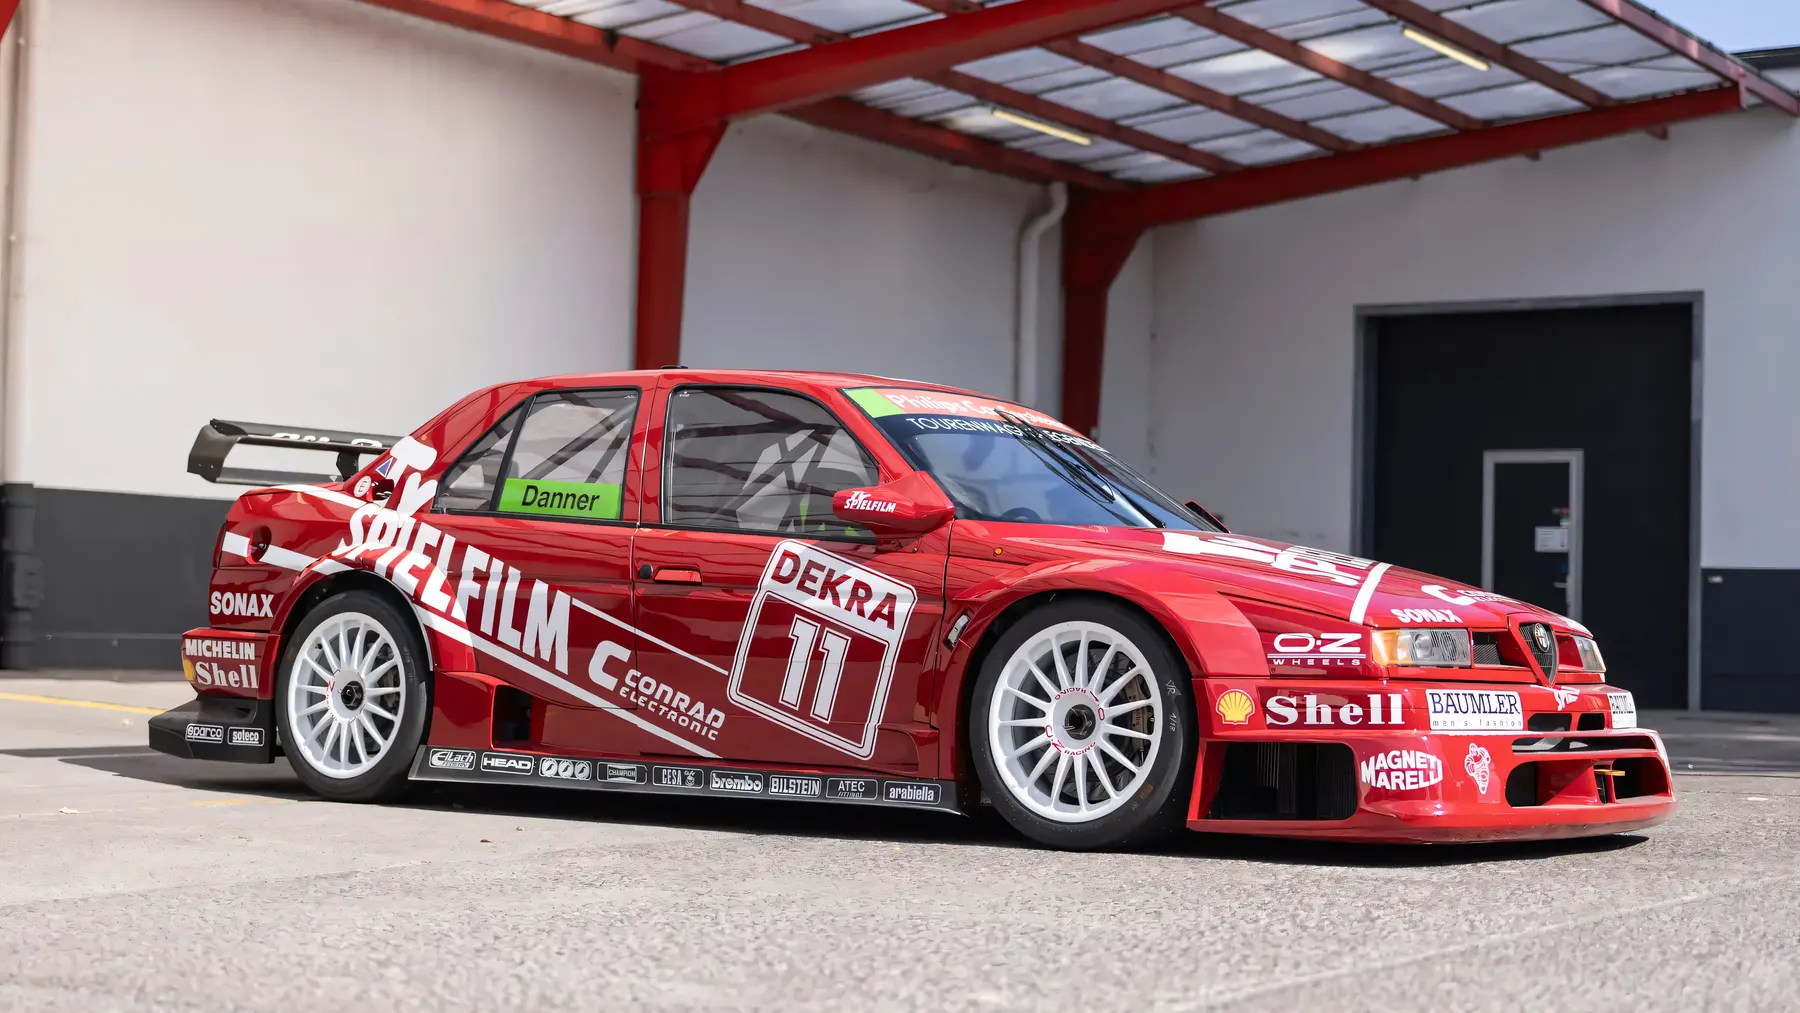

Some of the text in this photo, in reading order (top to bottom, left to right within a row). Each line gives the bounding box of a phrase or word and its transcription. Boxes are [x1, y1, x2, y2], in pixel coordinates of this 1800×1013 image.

[521, 485, 600, 512] Danner
[844, 498, 897, 513] SPIELFILM
[332, 506, 571, 675] SPIELFILM
[771, 550, 897, 630] DEKRA
[210, 591, 274, 618] SONAX
[1391, 608, 1464, 624] SONAX
[185, 638, 256, 661] MICHELIN
[779, 614, 852, 724] 11
[1273, 658, 1361, 666] WHEELS
[195, 661, 259, 689] Shell
[625, 669, 725, 728] CONRAD
[1266, 693, 1405, 725] Shell
[1429, 693, 1520, 714] BÄUMLER
[620, 687, 718, 740] ELECTRONIC
[483, 757, 531, 770] HEAD
[608, 767, 636, 778] CHAMPION
[662, 769, 682, 786] CESA
[712, 773, 762, 791] brembo
[771, 776, 819, 795] BILSTEIN
[838, 780, 865, 792] ATEC
[889, 785, 935, 801] arabiella
